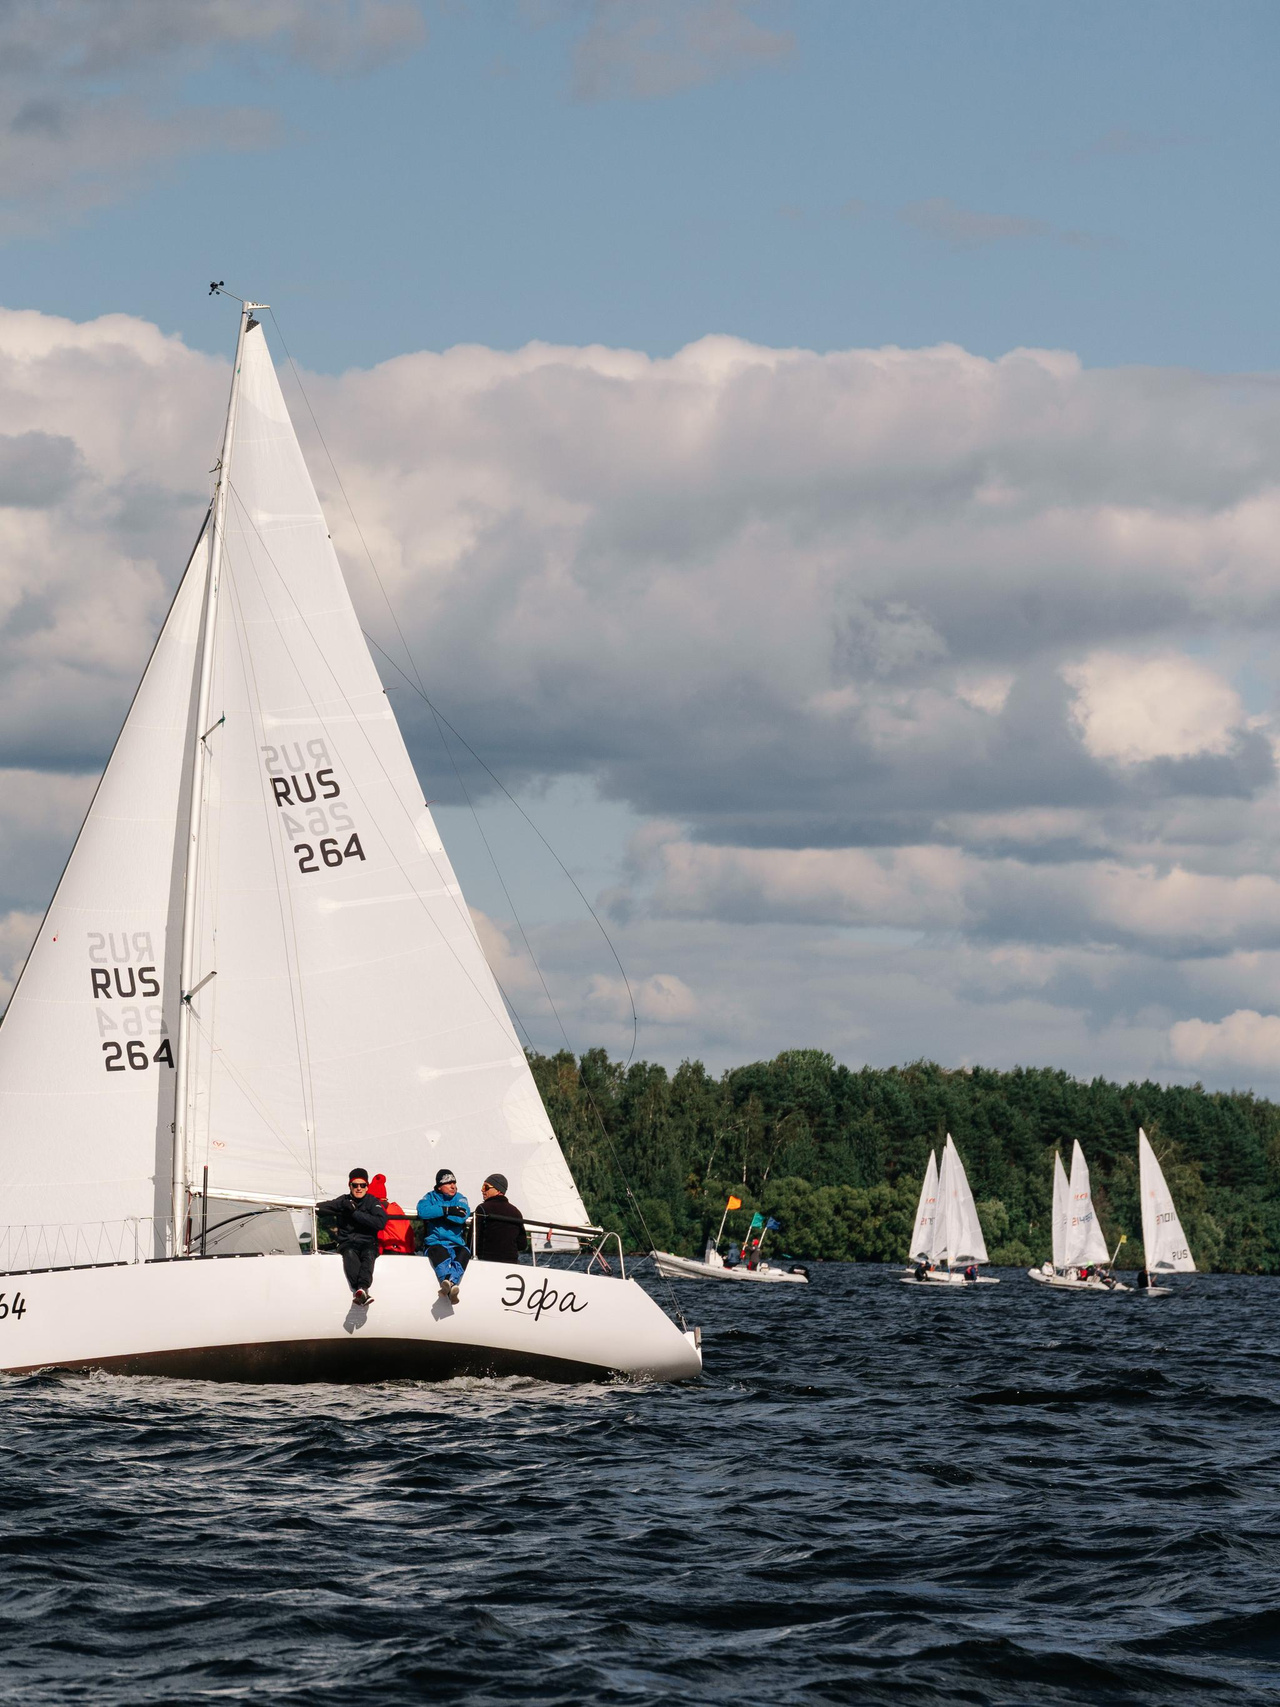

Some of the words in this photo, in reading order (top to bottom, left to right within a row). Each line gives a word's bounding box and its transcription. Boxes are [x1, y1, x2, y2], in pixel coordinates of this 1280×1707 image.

[269, 768, 341, 807] RUS
[293, 832, 367, 874] 264
[90, 966, 160, 999] RUS
[101, 1038, 175, 1072] 264
[501, 1273, 589, 1322] Эфа
